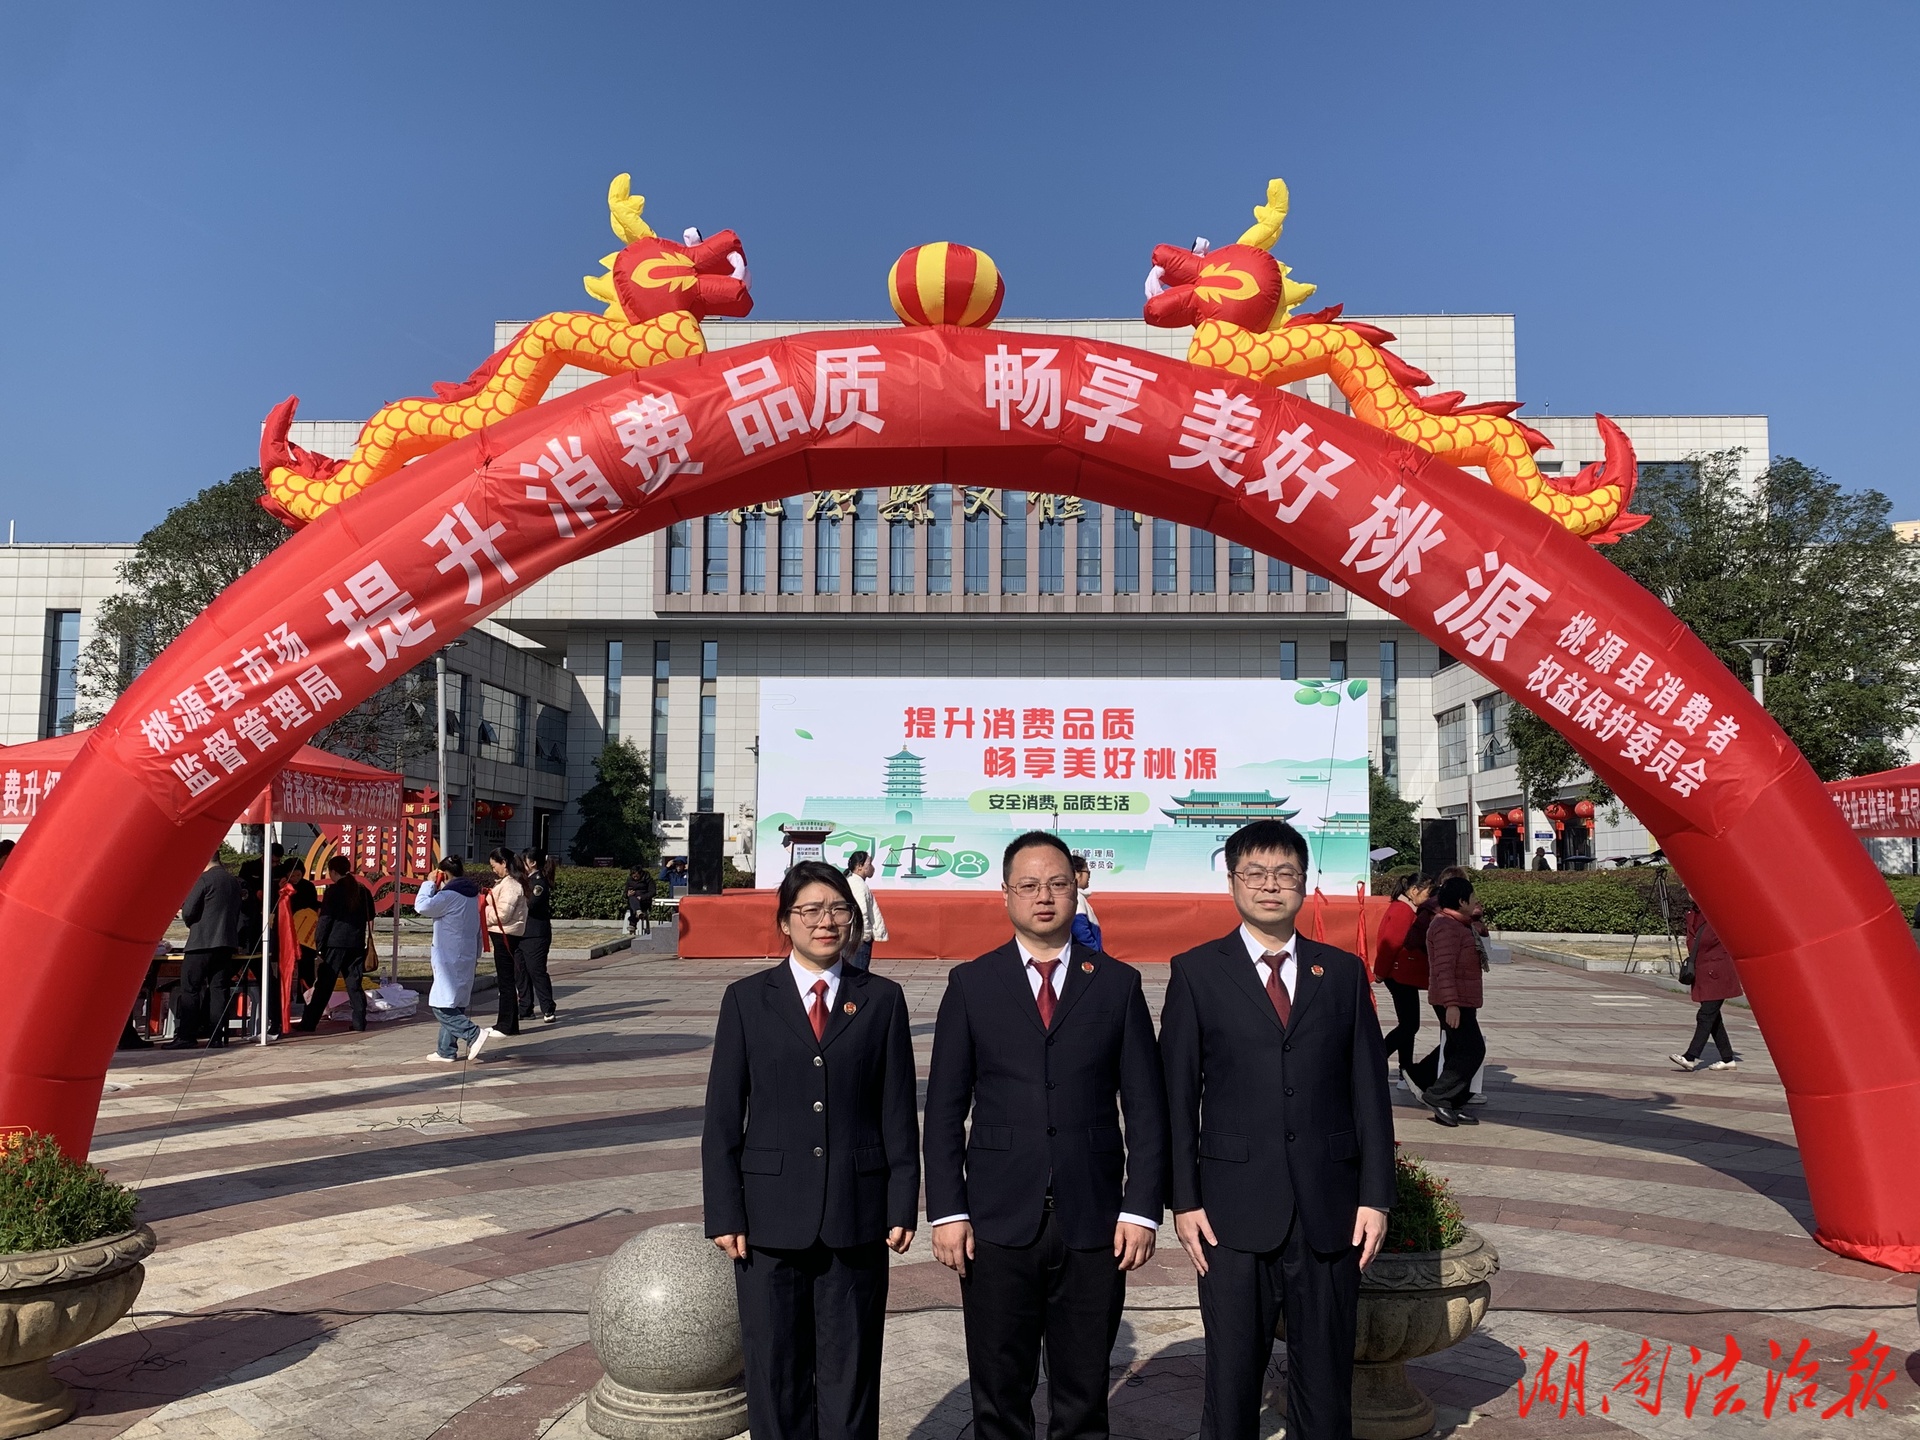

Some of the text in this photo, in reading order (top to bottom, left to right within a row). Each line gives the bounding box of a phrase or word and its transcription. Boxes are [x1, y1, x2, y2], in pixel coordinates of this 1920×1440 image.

[322, 344, 1551, 673] 提升消费品质 畅享美好桃源
[140, 621, 310, 754] 桃源县市场
[169, 664, 343, 798] 监督管理局
[904, 706, 1135, 740] 提升消费品质
[1525, 654, 1708, 798] 权益保护委员会
[1556, 610, 1741, 755] 桃源县消费者
[984, 746, 1217, 780] 畅享美好桃源
[989, 794, 1130, 811] 安全消费 品质生活
[415, 822, 428, 869] 创文明城
